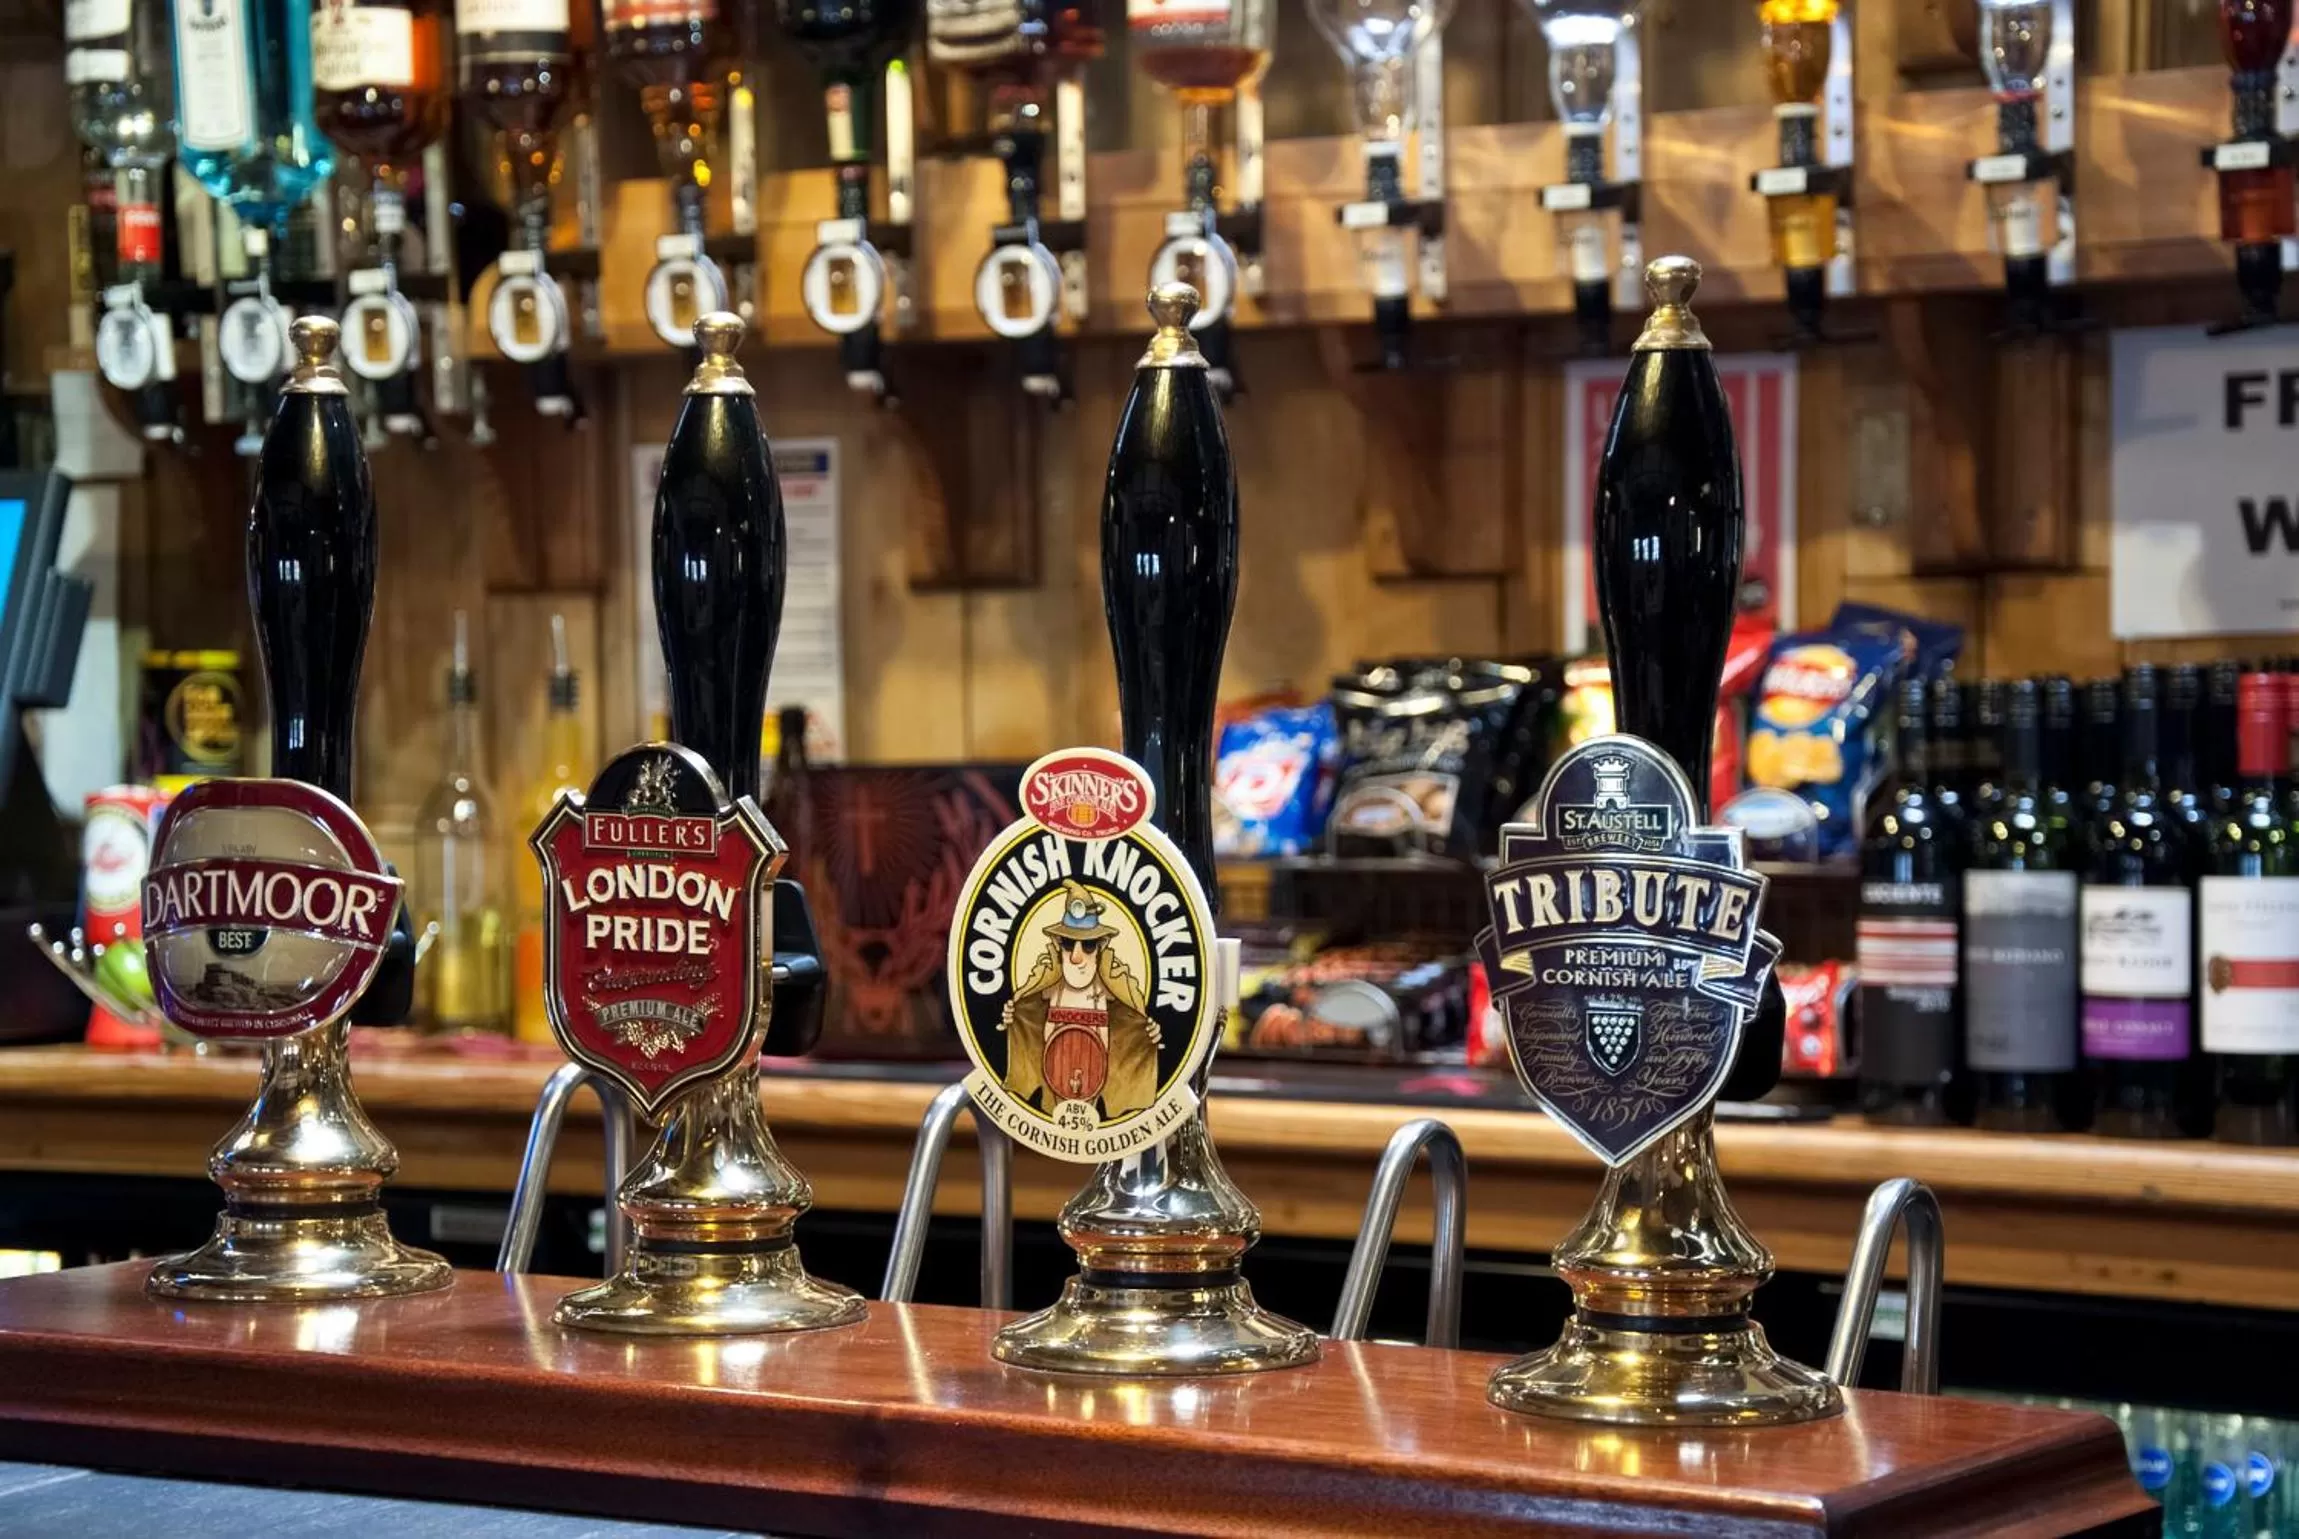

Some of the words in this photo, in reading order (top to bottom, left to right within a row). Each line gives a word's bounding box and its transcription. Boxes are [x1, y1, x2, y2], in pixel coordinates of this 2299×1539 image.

[593, 817, 706, 847] FULLER'S
[145, 870, 377, 938] DARTMOOR
[561, 863, 736, 921] LONDON
[1494, 869, 1750, 942] TRIBUTE
[586, 914, 711, 955] PRIDE
[968, 834, 1073, 995] CORNISH
[1083, 839, 1197, 1013] KNOCKER
[218, 930, 252, 949] BEST
[1564, 949, 1663, 966] PREMIUM
[1542, 968, 1637, 987] CORNISH
[1644, 971, 1689, 989] ALE
[601, 1000, 667, 1021] PREMIUM
[672, 1005, 699, 1028] ALE
[1050, 1010, 1107, 1023] KNOCKERS
[1648, 1023, 1723, 1046] Hundred
[976, 1080, 1007, 1118] THE
[1008, 1112, 1079, 1155] CORNISH
[1085, 1121, 1152, 1155] GOLDEN
[1155, 1098, 1183, 1131] ALE
[1066, 1103, 1087, 1114] ABV
